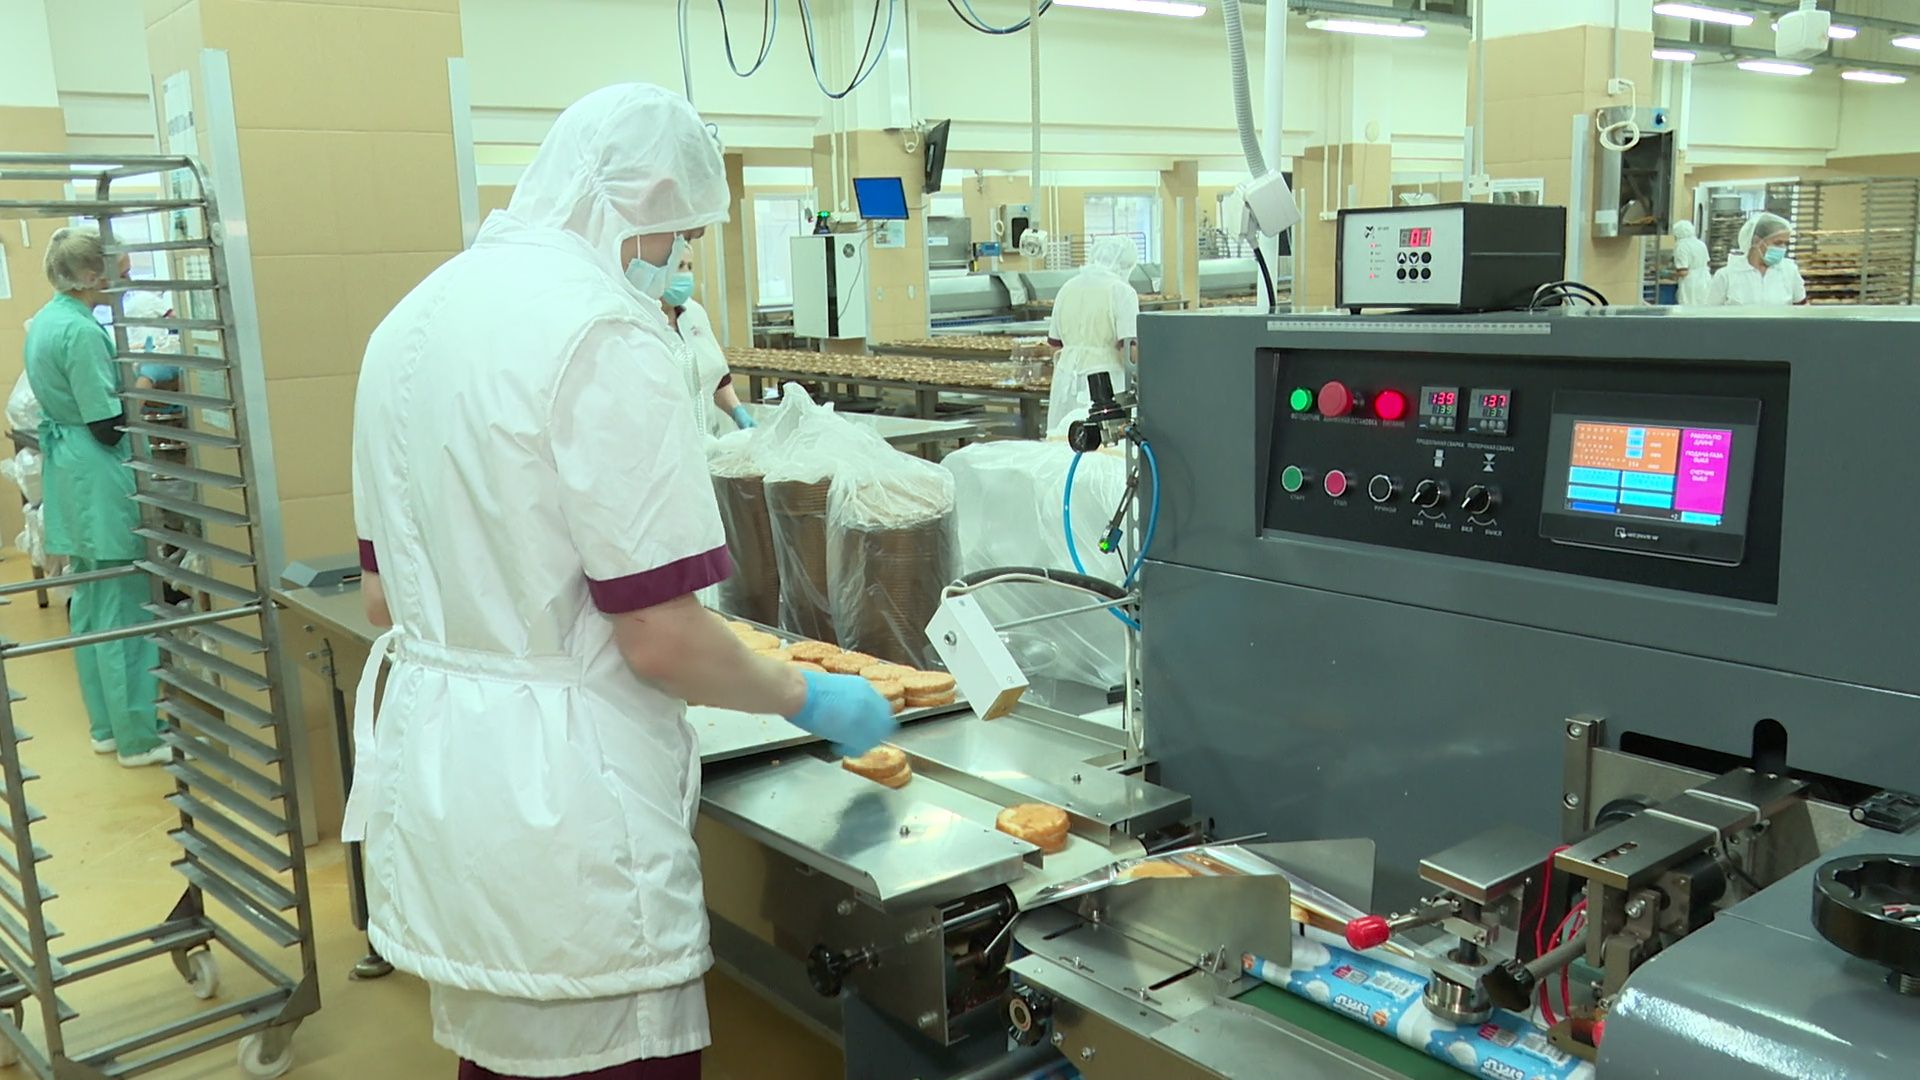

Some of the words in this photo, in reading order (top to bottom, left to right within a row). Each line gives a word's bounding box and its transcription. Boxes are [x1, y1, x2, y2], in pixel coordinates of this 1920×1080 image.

[1432, 391, 1456, 405] 139
[1483, 394, 1507, 408] 137
[1436, 405, 1453, 414] 139
[1486, 408, 1504, 417] 137
[1447, 440, 1464, 448] СВАРКА
[1412, 518, 1424, 526] ВКЛ
[1461, 525, 1473, 533] ВКЛ
[1485, 529, 1503, 537] ВЫКЛ
